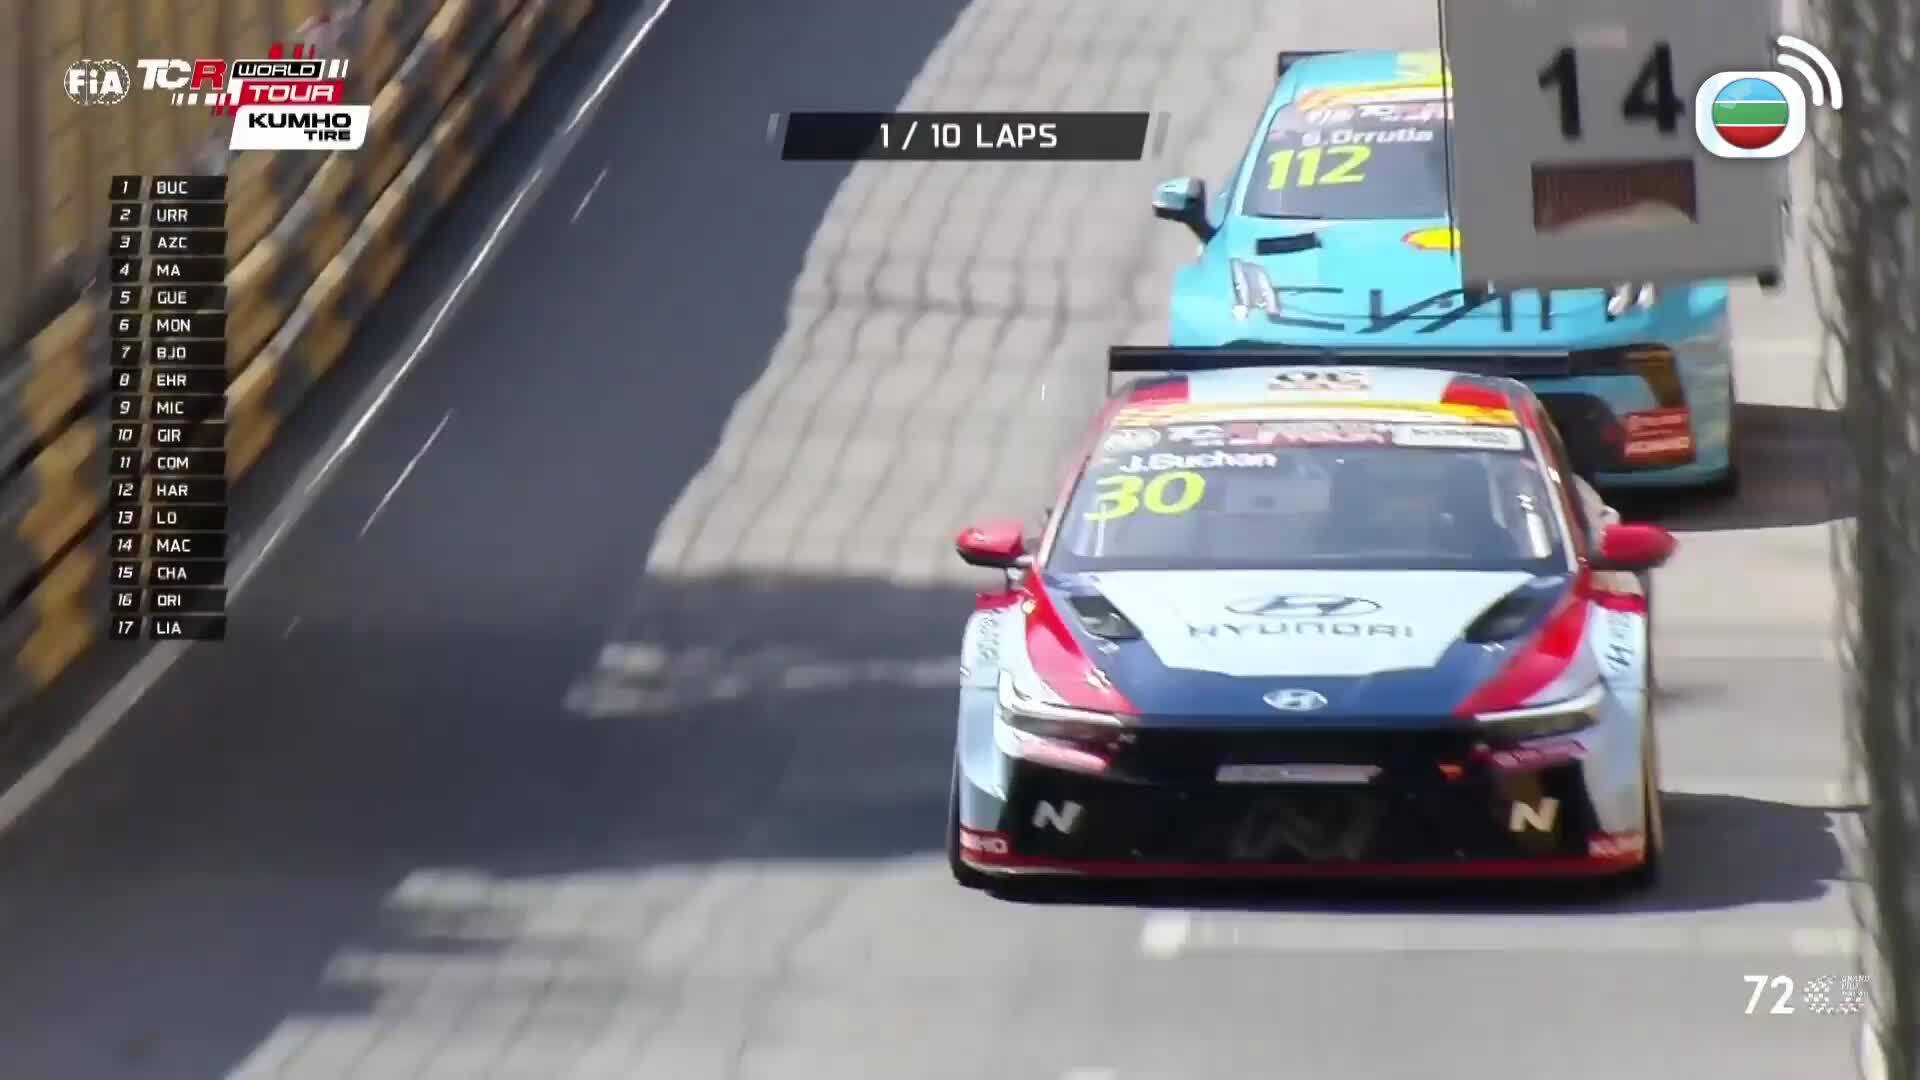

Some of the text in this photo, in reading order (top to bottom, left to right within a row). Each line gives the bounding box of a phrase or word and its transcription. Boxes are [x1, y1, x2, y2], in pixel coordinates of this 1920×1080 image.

[1537, 40, 1686, 140] 14
[1267, 146, 1371, 191] 112
[1082, 470, 1206, 521] 30
[1032, 800, 1084, 834] N
[1509, 797, 1560, 832] N
